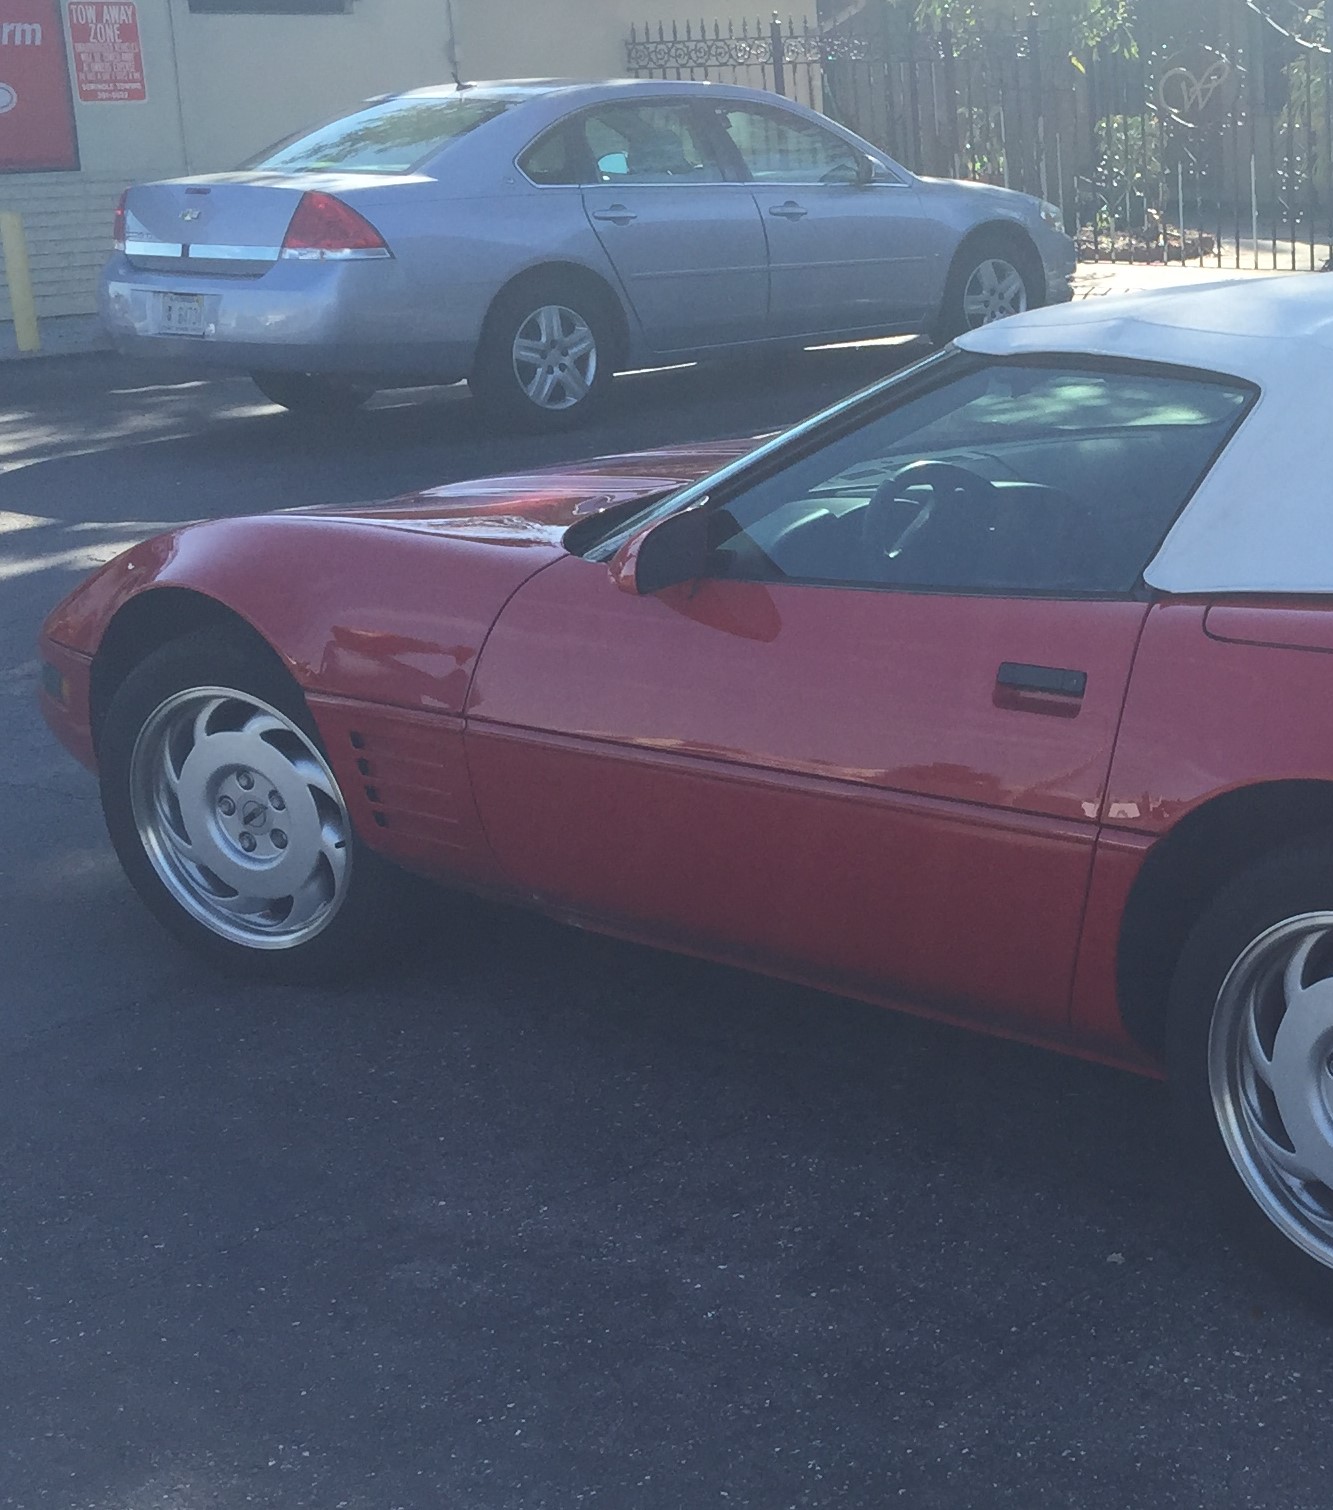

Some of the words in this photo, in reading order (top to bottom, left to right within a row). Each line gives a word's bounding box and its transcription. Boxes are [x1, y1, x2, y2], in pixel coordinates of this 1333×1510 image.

[70, 5, 96, 24] TOW
[103, 5, 133, 24] AWAY
[89, 24, 122, 42] ZONE
